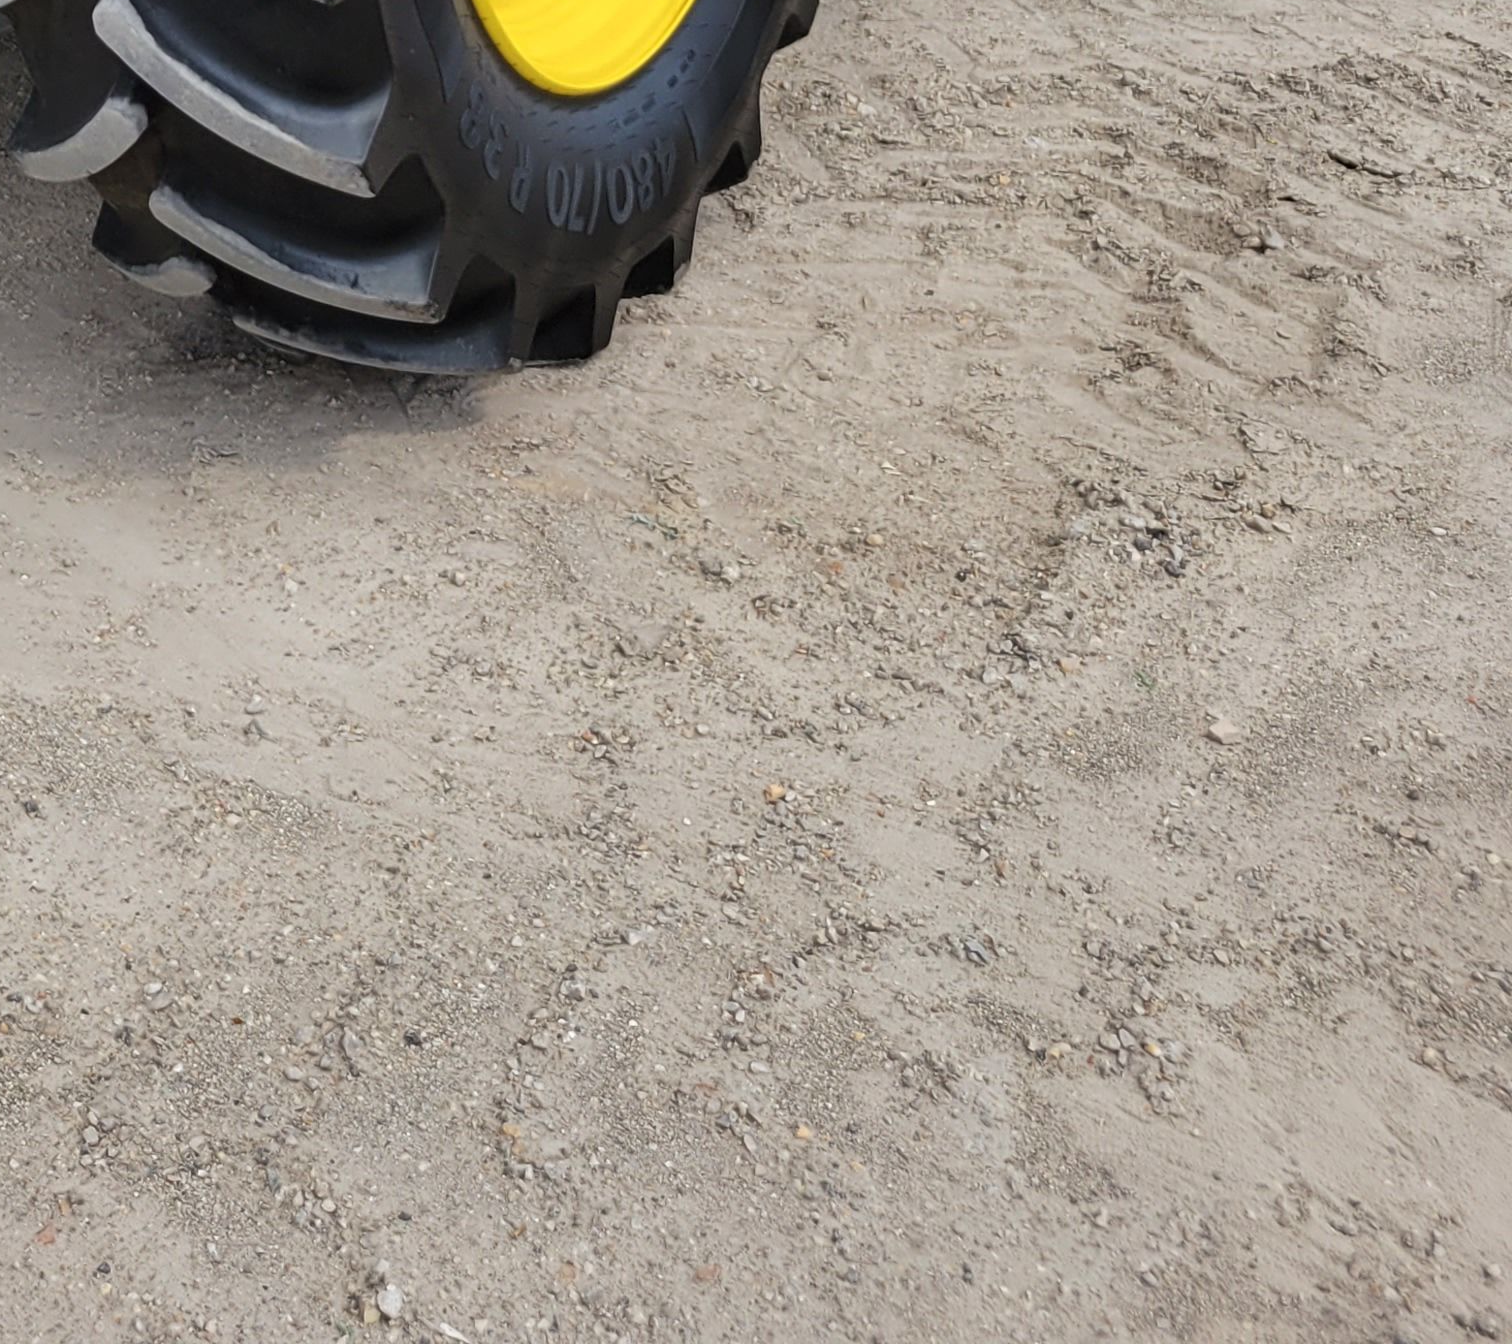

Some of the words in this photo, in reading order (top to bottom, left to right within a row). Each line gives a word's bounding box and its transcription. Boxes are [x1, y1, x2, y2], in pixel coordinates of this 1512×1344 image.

[459, 79, 510, 180] 38
[508, 139, 532, 213] R
[544, 135, 677, 236] 480/70
